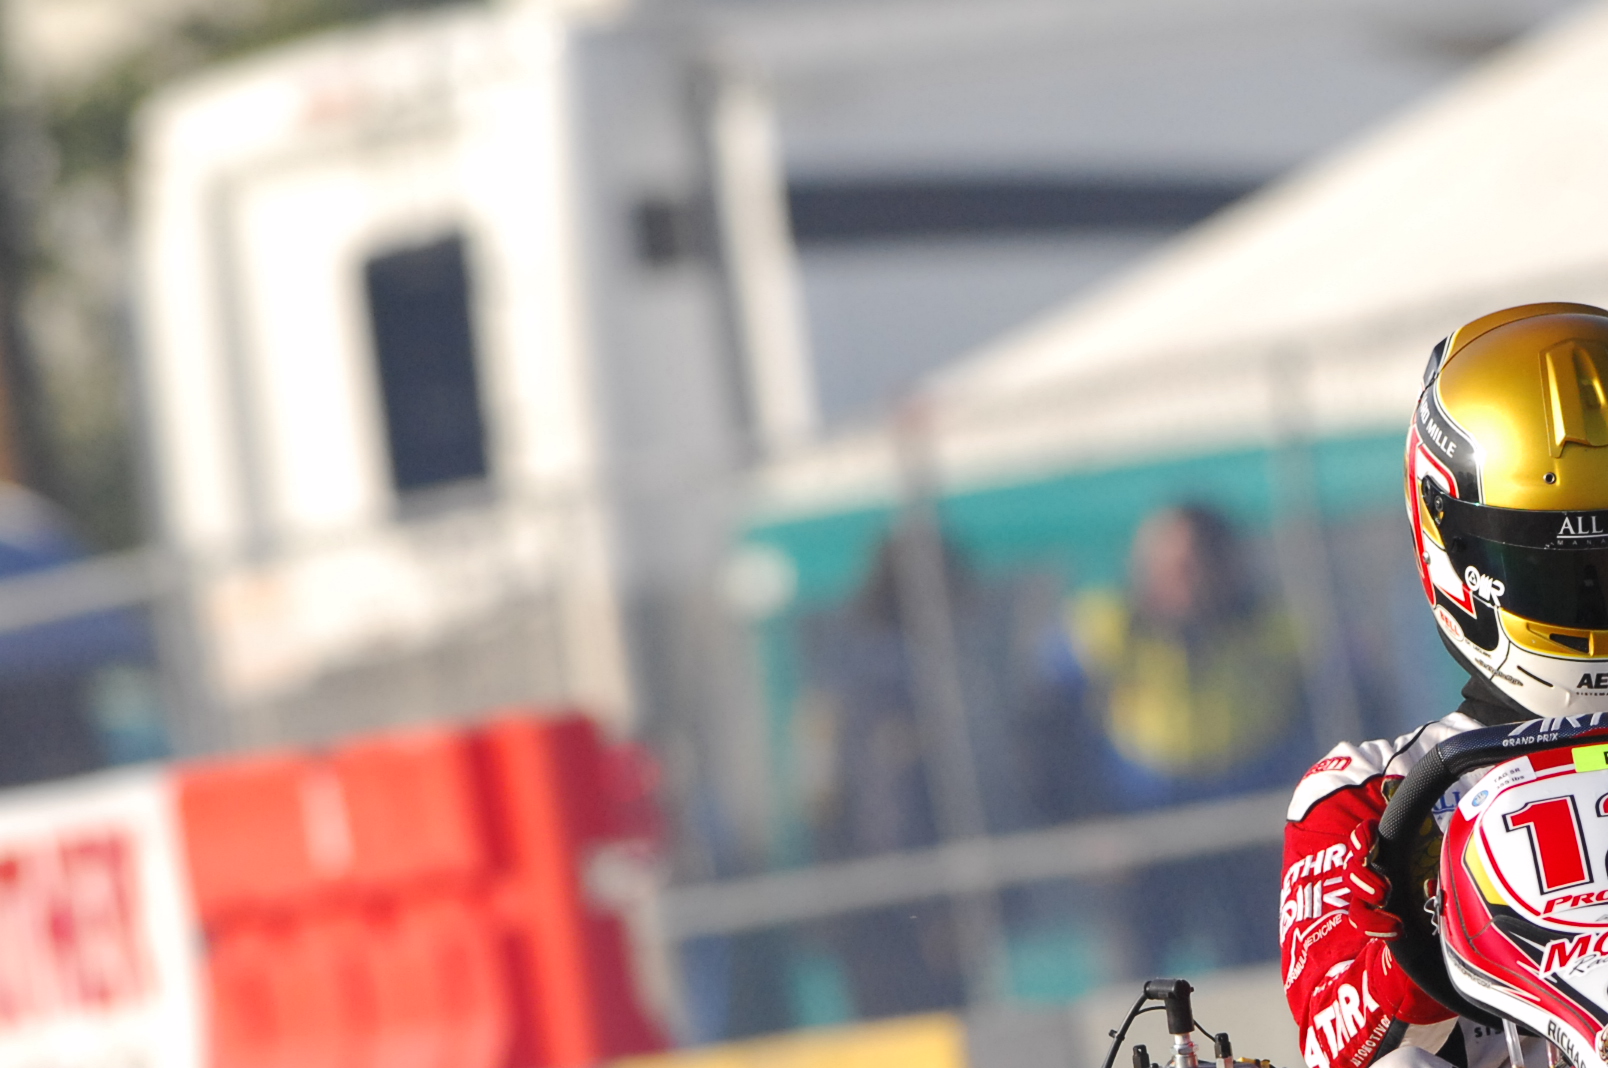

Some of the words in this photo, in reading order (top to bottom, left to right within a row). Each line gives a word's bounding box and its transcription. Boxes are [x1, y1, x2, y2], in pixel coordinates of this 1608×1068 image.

[1426, 418, 1457, 459] MILLE
[1558, 516, 1603, 535] ALL
[1502, 736, 1535, 747] GRAND
[1537, 732, 1558, 743] PRIX
